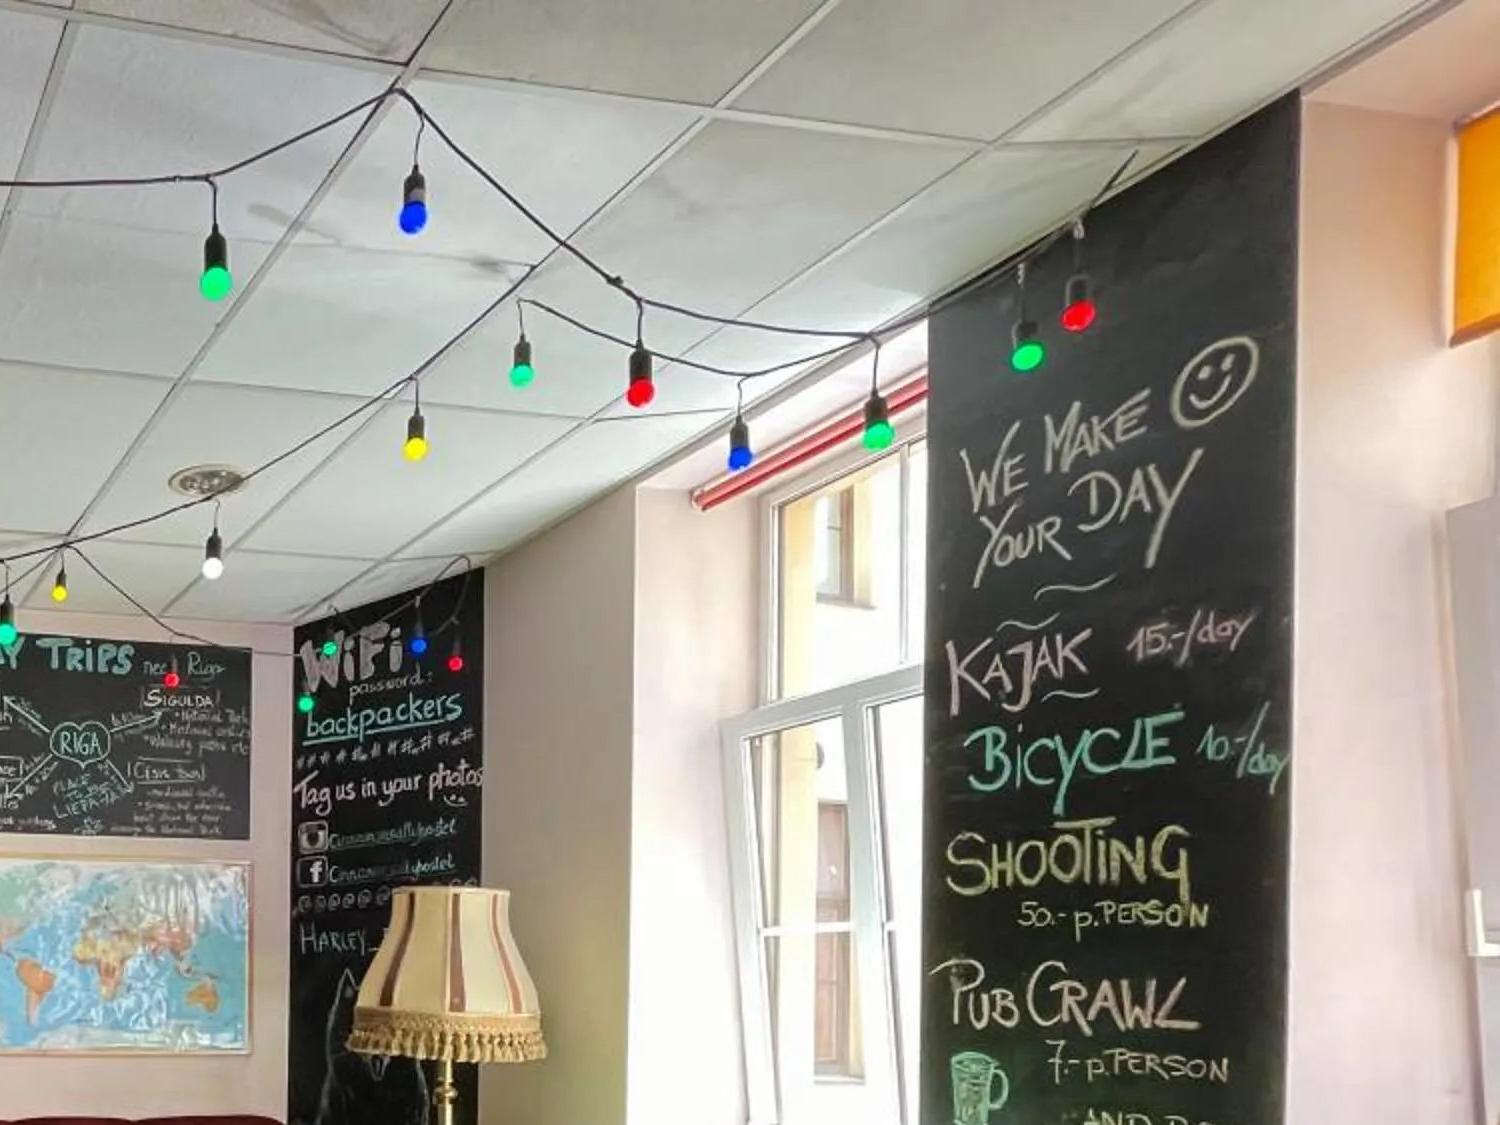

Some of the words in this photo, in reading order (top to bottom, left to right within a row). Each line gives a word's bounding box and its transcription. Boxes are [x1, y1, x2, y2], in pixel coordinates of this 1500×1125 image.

[960, 420, 1028, 513] WE
[1044, 387, 1151, 474] MAKE
[973, 498, 1072, 589] YOUR
[1067, 448, 1205, 569] DAY
[945, 628, 1092, 716] KAJAK
[60, 731, 100, 756] RIGA
[307, 692, 463, 743] backpackers
[293, 770, 332, 816] Tag
[336, 783, 357, 800] us
[362, 777, 376, 797] in
[378, 774, 422, 807] your
[299, 920, 367, 956] HARLEY
[929, 958, 1019, 1029] PUB
[1027, 960, 1201, 1036] CRAWL
